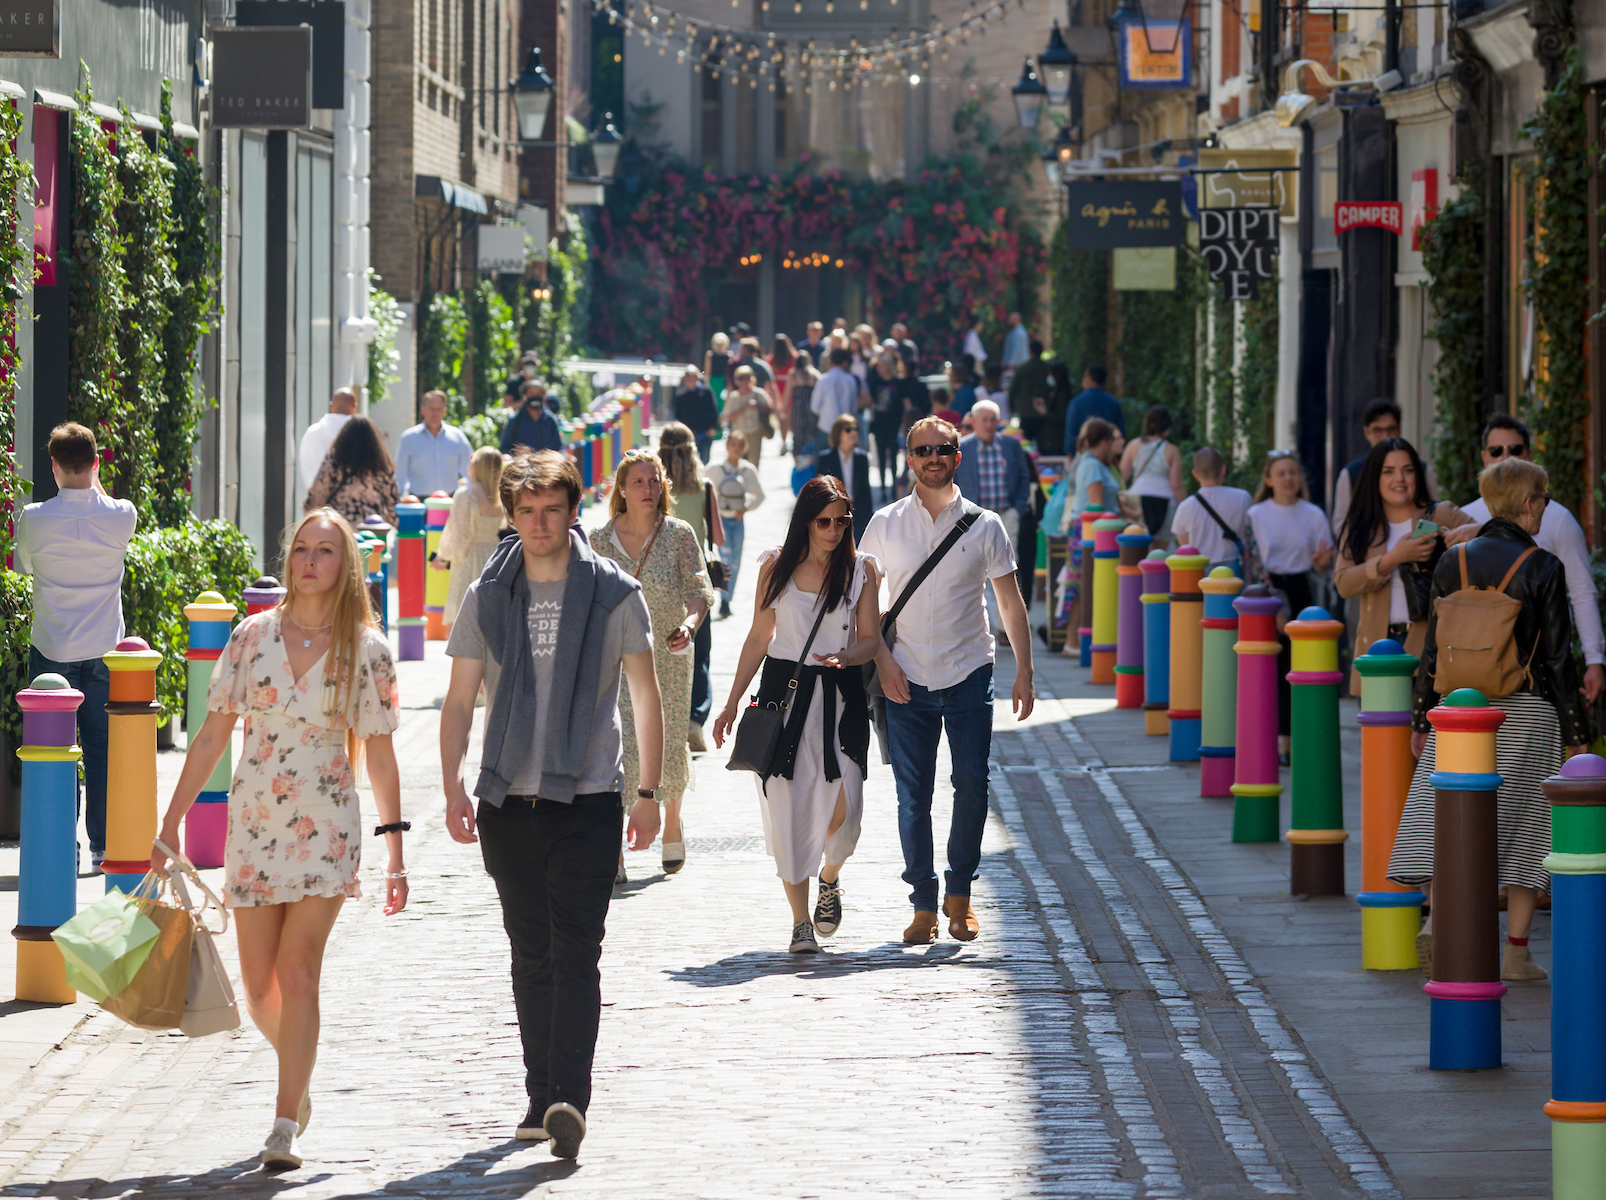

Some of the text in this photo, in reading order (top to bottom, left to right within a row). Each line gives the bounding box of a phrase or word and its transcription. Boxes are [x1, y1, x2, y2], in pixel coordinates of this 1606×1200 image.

[220, 97, 299, 108] TED BAKER
[1127, 218, 1171, 230] PARIS
[1199, 209, 1279, 240] DIPT
[1338, 205, 1399, 229] CAMPER
